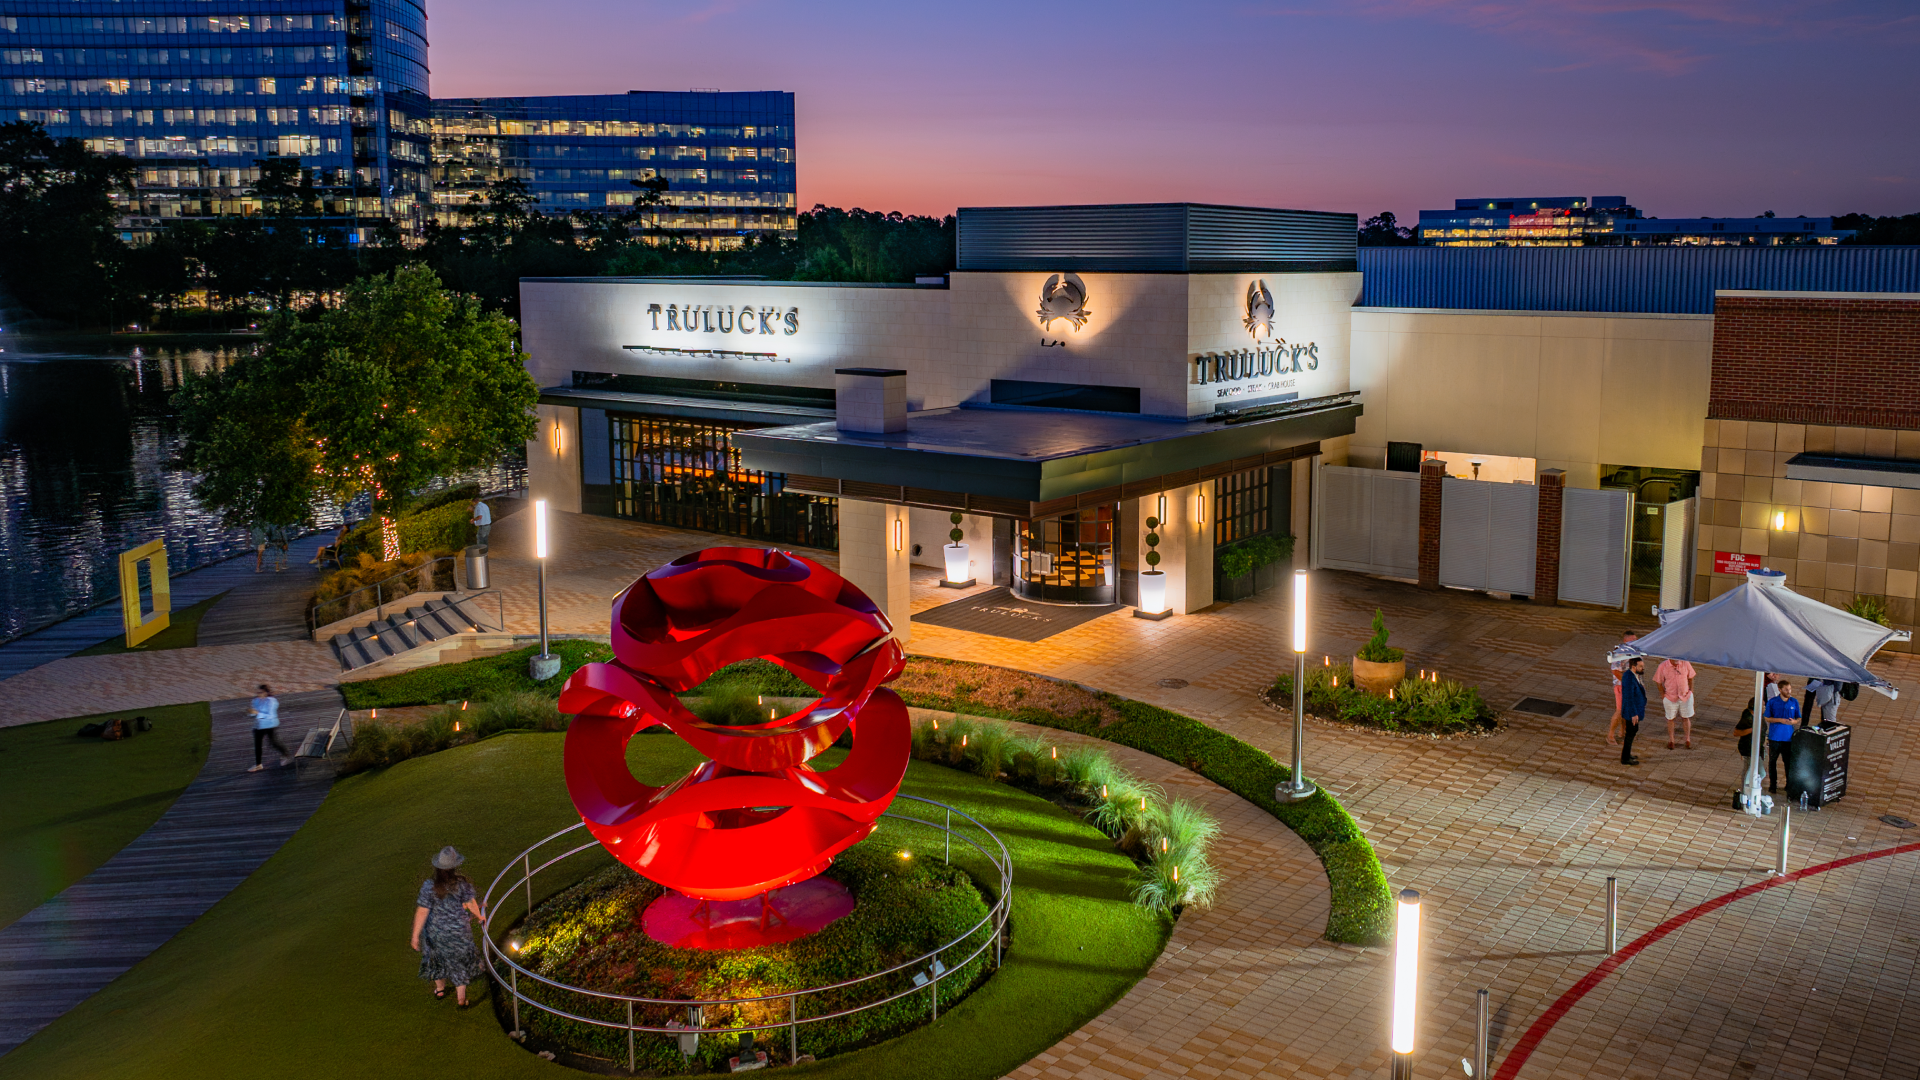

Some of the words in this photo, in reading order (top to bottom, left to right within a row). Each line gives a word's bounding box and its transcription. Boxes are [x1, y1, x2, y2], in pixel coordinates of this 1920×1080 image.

[647, 307, 799, 336] TRULUCK'S
[1196, 342, 1319, 385] TRULUCK'S
[1267, 381, 1280, 390] CRAB
[1280, 379, 1296, 389] HOUSE
[1730, 553, 1746, 562] FDC
[1829, 738, 1846, 751] VALET
